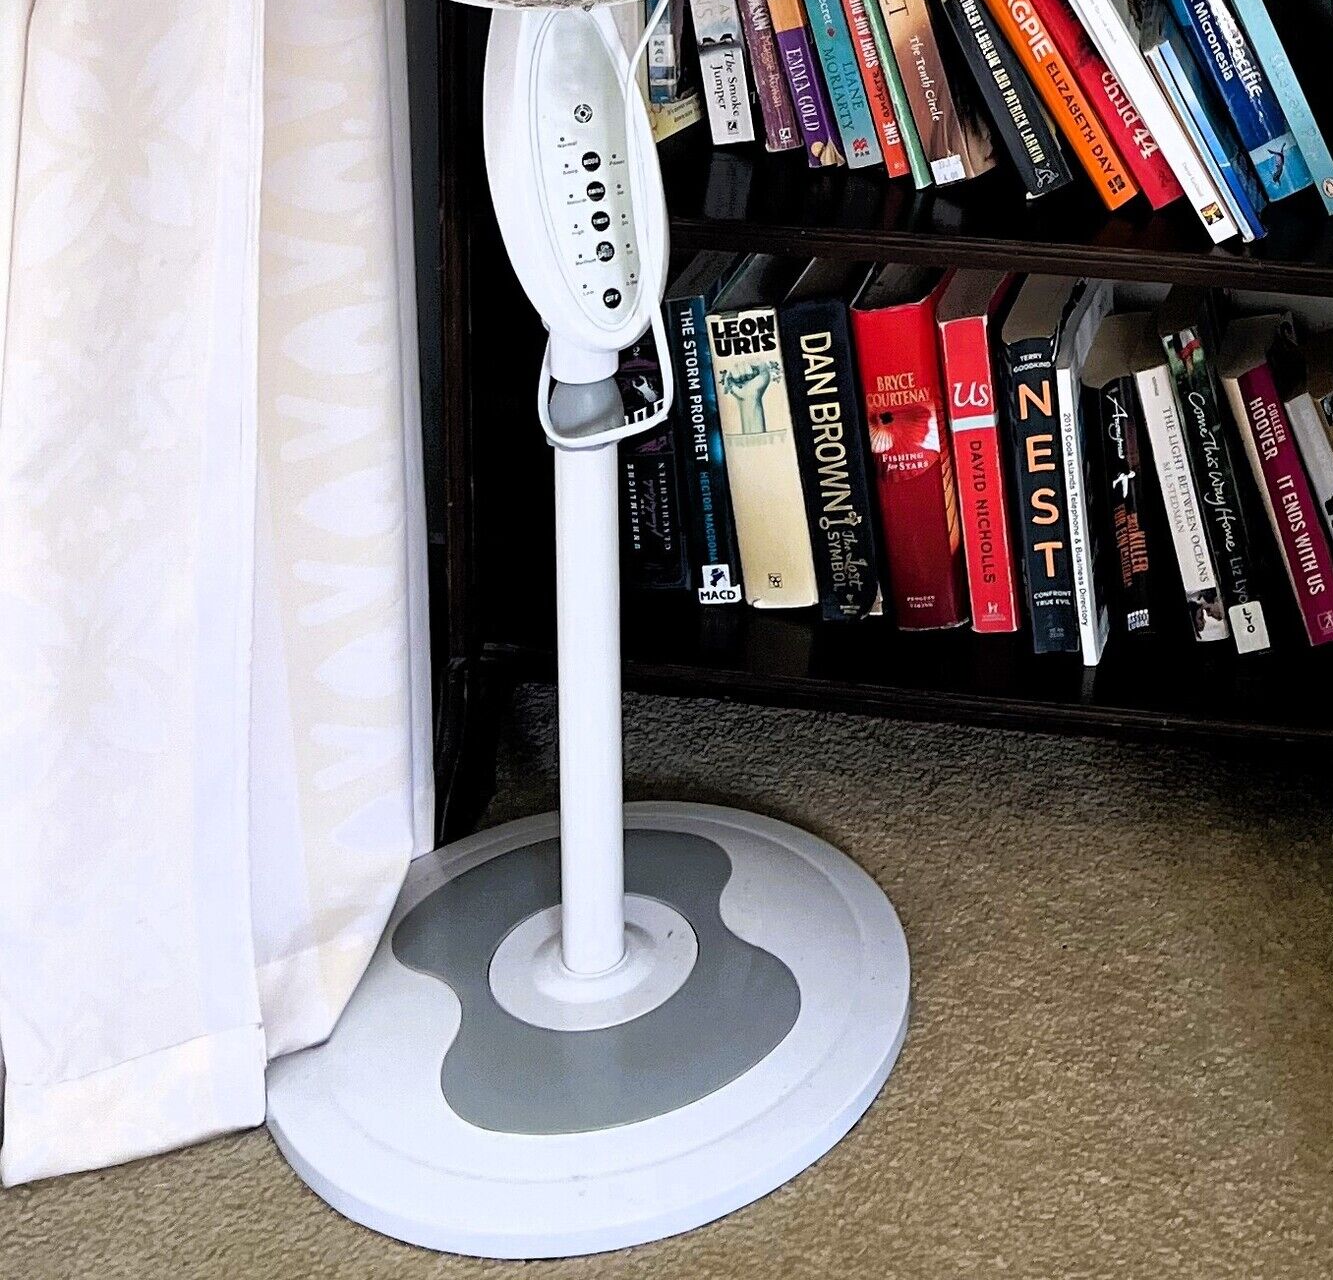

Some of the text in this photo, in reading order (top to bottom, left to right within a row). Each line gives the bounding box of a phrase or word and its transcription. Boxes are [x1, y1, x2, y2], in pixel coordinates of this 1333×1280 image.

[859, 39, 880, 69] SICHT
[1194, 1, 1235, 83] Micronesia
[710, 64, 726, 110] Jumper
[723, 50, 740, 117] The Smoke
[785, 46, 821, 132] EMMA GOLD
[822, 47, 855, 131] MORIARTY
[841, 60, 865, 112] LIANE
[909, 34, 944, 122] The Tenth Circle
[1229, 34, 1264, 100] Pacific
[882, 120, 901, 146] EINE
[991, 62, 1012, 91] AND
[1002, 87, 1032, 133] PATRICK
[1019, 126, 1046, 164] LARKIN
[1045, 60, 1097, 142] ELIZABETH
[1091, 140, 1116, 175] DAY
[1130, 124, 1160, 162] 44
[710, 314, 776, 340] LEON
[714, 336, 777, 358] URIS
[1012, 361, 1052, 374] GOODKIND
[1019, 352, 1043, 362] TERRY
[680, 308, 709, 463] THE STORM PROPHET
[865, 386, 931, 408] COURTENAY
[876, 371, 916, 392] BRYCE
[800, 331, 853, 512] DAN BROWN
[1062, 412, 1072, 432] 2019
[1249, 396, 1279, 461] HOOVER
[1266, 402, 1287, 443] COLLEEN
[1064, 434, 1075, 456] Cook
[1017, 379, 1063, 578] NEST
[1162, 405, 1210, 584] THE LIGHT BETWEEN OCEANS
[1188, 391, 1248, 605] Come This Way Home Liz Lyo
[700, 471, 718, 563] HECTOR MACDONA
[969, 439, 997, 585] DAVID NICHOLLS
[1070, 491, 1081, 536] Telephone
[1166, 480, 1185, 534] STEDMAN
[1128, 530, 1150, 575] KILLER
[1276, 474, 1326, 596] IT ENDS WITH US
[826, 530, 845, 592] SYMBOL
[1075, 545, 1084, 585] Business
[700, 589, 737, 602] MACD
[1033, 589, 1072, 600] CONFRONT
[1035, 597, 1072, 607] TRUE EVIL
[1078, 588, 1089, 627] Directory
[1241, 607, 1255, 634] LYO
